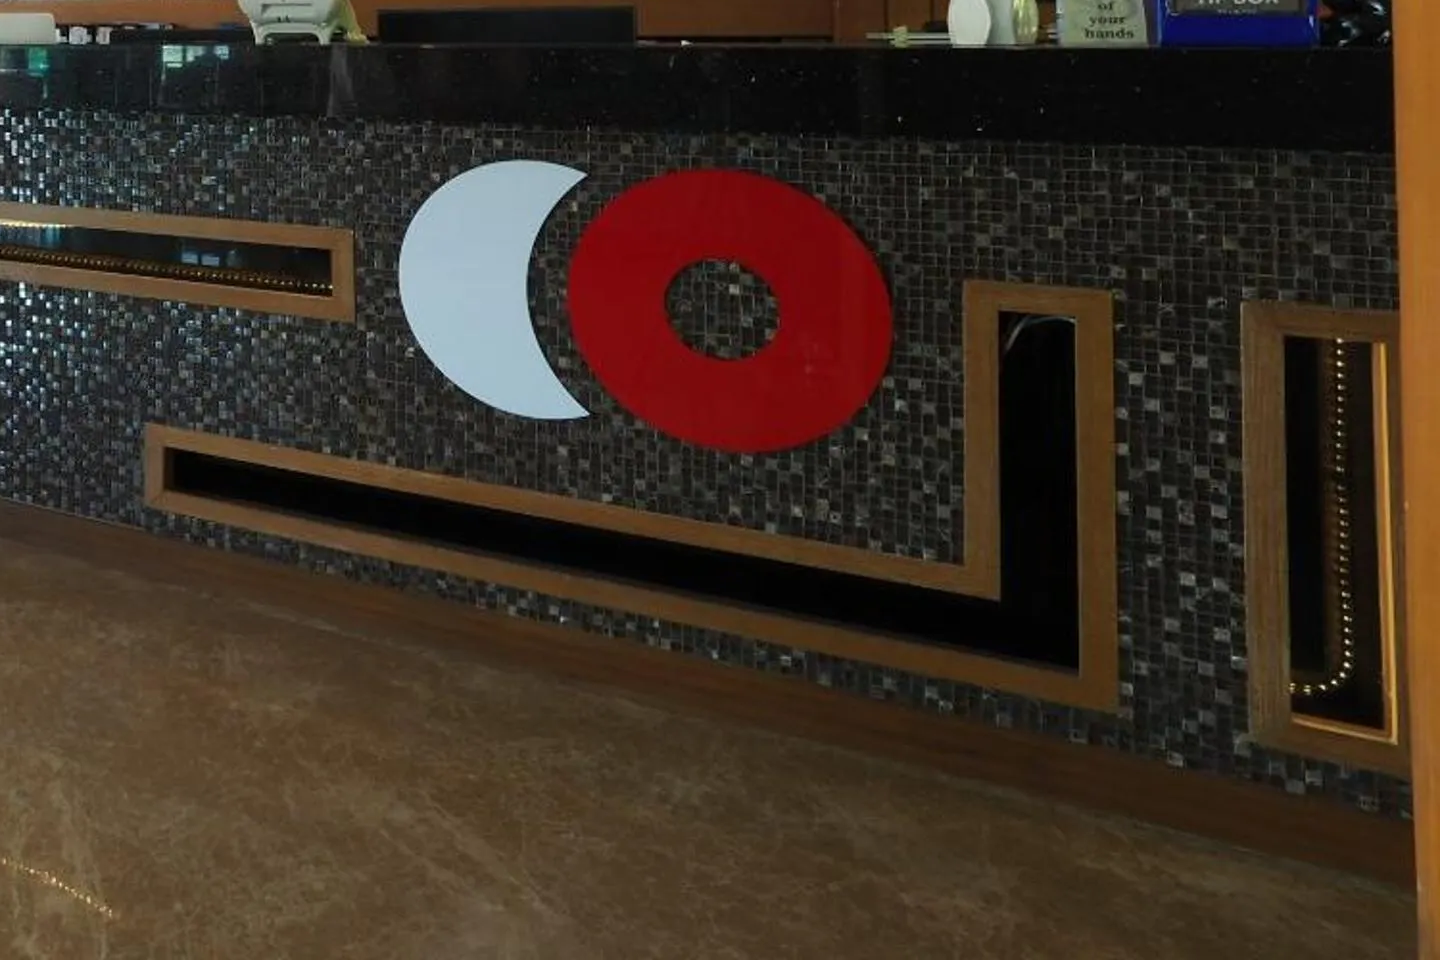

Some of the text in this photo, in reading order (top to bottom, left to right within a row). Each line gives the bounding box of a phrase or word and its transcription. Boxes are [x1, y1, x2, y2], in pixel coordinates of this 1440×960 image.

[1097, 1, 1113, 11] of
[1088, 16, 1126, 27] your
[1084, 27, 1135, 39] hands
